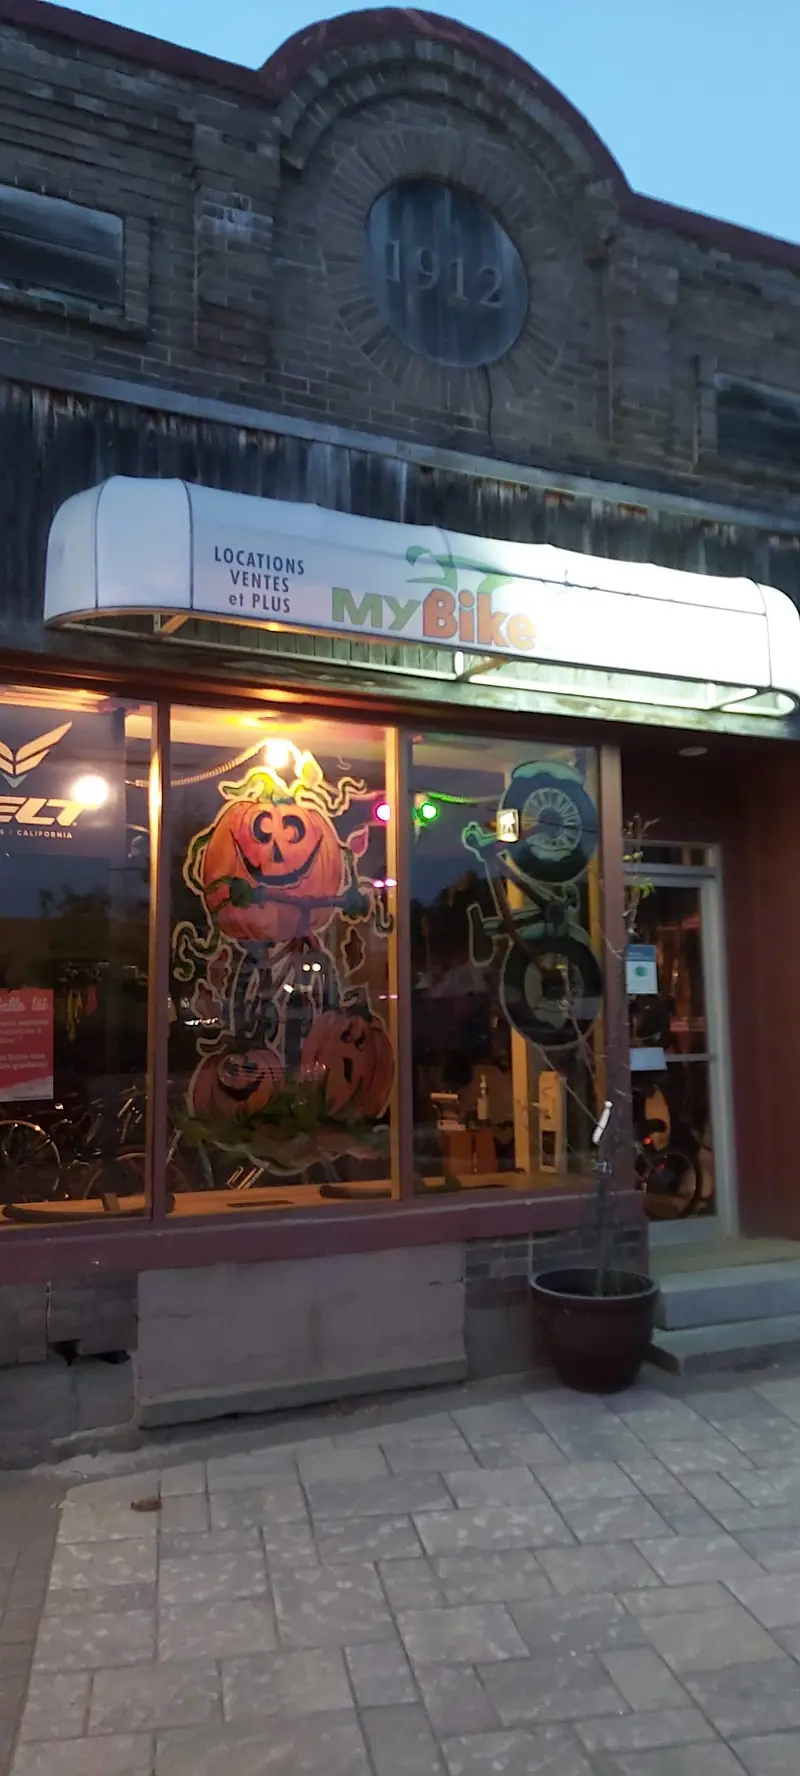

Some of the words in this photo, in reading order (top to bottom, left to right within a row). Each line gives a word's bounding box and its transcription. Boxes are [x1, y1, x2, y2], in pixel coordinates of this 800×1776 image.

[386, 239, 502, 308] 1912
[214, 546, 305, 575] LOCATIONS
[229, 568, 289, 593] VENTES
[228, 593, 244, 607] et
[252, 592, 290, 613] PLUS
[16, 829, 73, 839] CALIFORNIA
